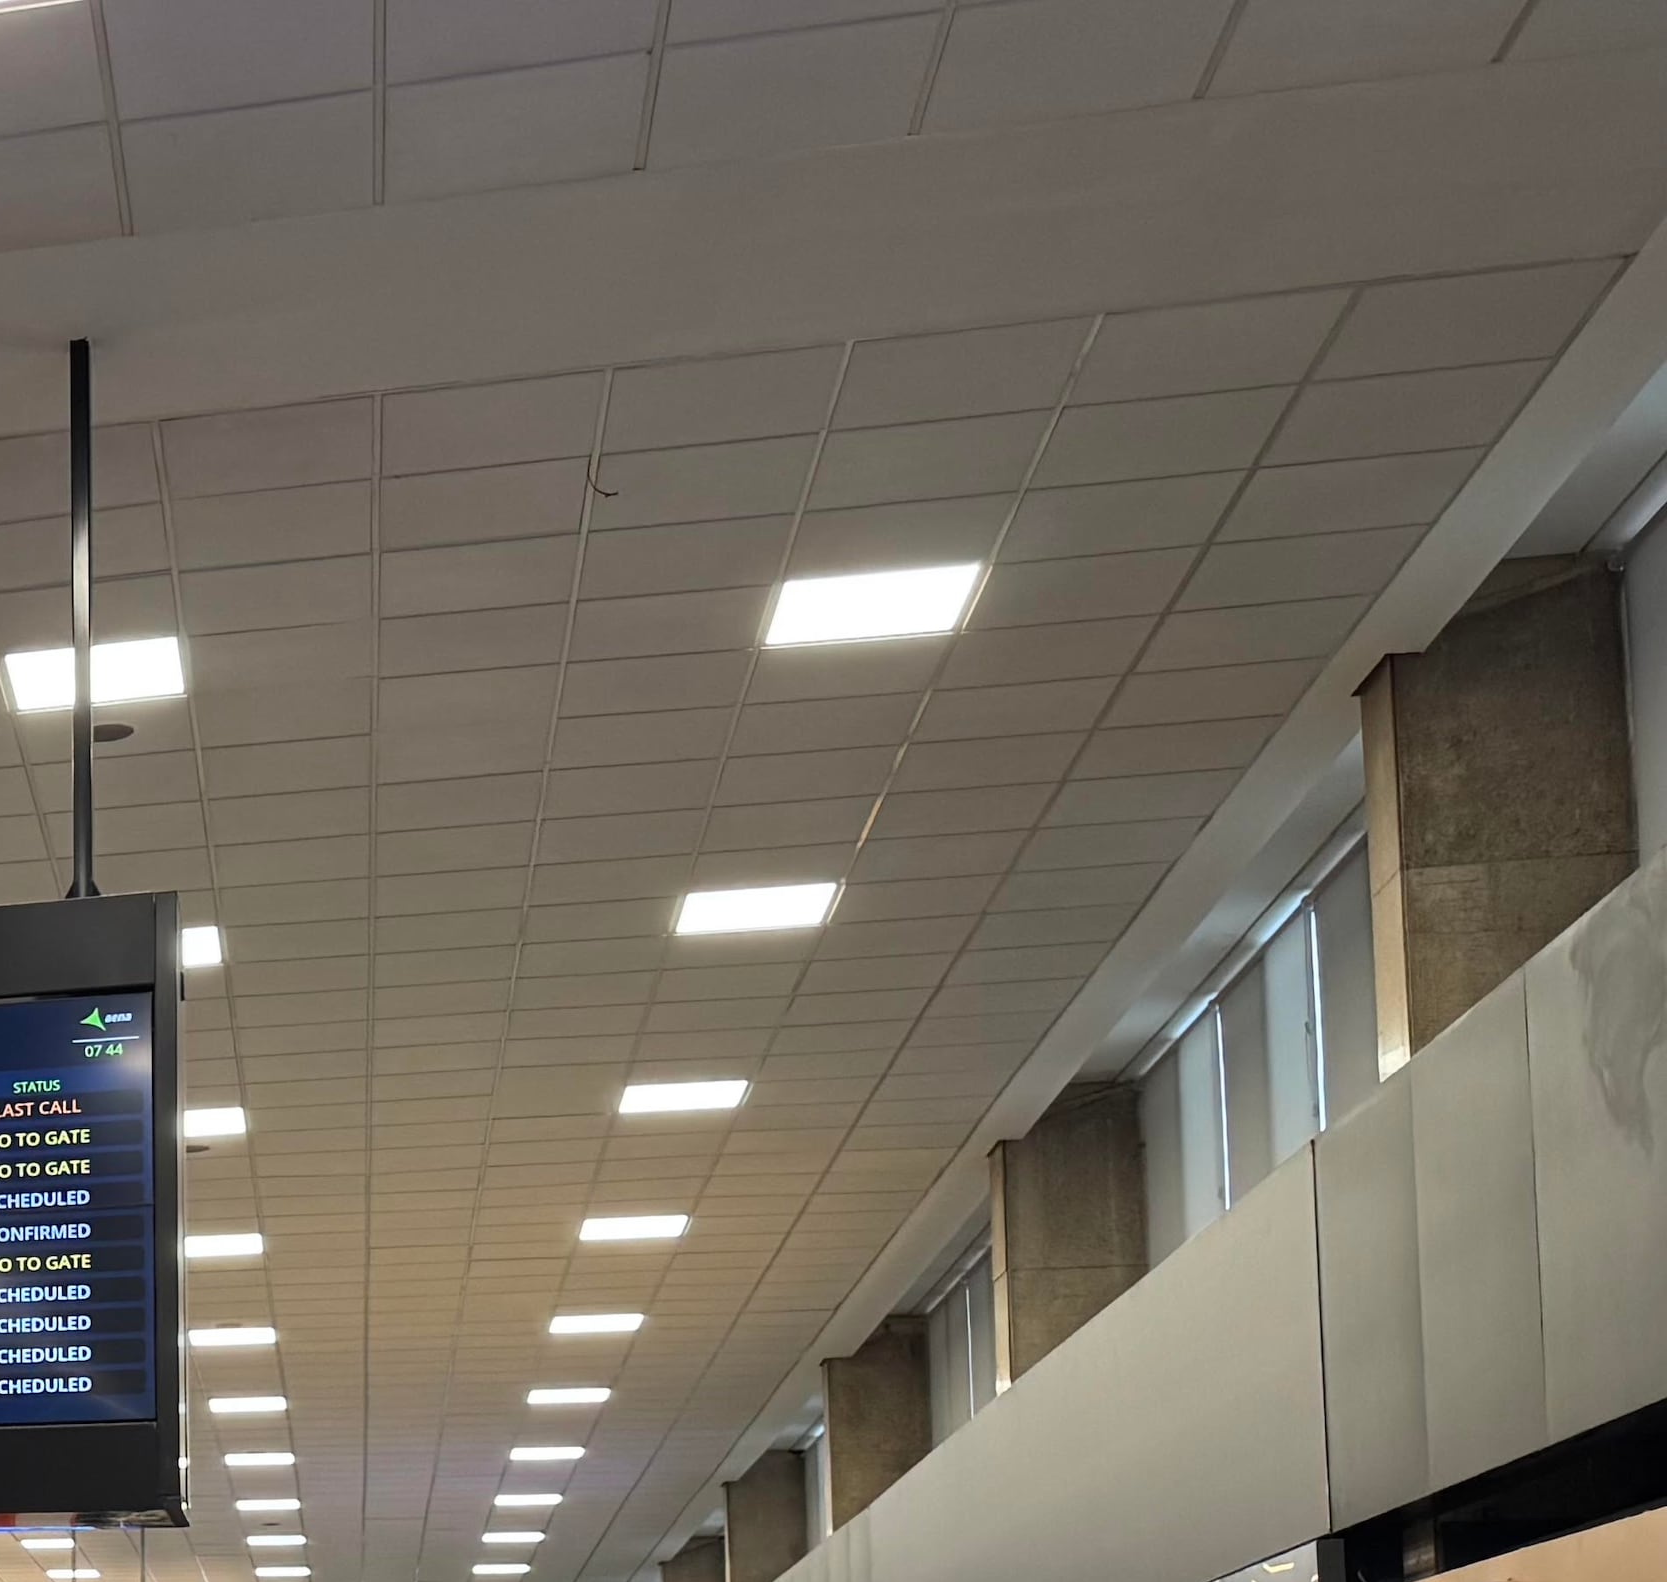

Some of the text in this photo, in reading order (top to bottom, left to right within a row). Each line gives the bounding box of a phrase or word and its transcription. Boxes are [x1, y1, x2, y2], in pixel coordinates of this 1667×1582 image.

[12, 1079, 61, 1094] STATUS
[38, 1099, 82, 1119] CALL
[14, 1131, 41, 1148] TO
[44, 1128, 91, 1150] GATE
[14, 1161, 41, 1178] TO
[44, 1159, 91, 1180] GATE
[15, 1256, 42, 1272] TO
[45, 1253, 92, 1271] GATE
